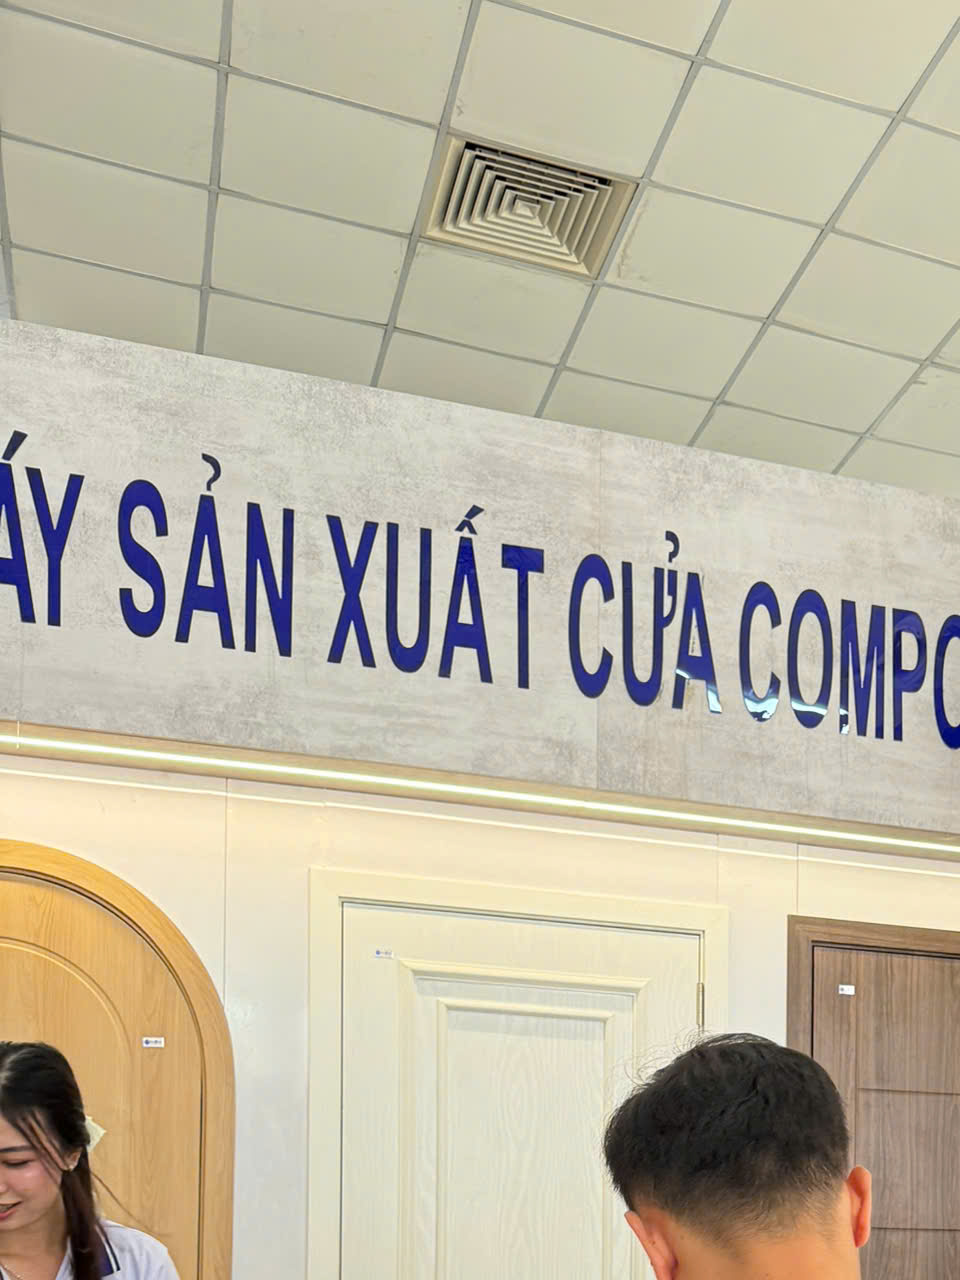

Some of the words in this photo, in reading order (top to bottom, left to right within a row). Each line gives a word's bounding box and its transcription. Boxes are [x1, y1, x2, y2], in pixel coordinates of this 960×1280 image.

[118, 453, 294, 657] SẢN
[326, 505, 545, 690] XUẤT
[568, 531, 722, 714] CỬA
